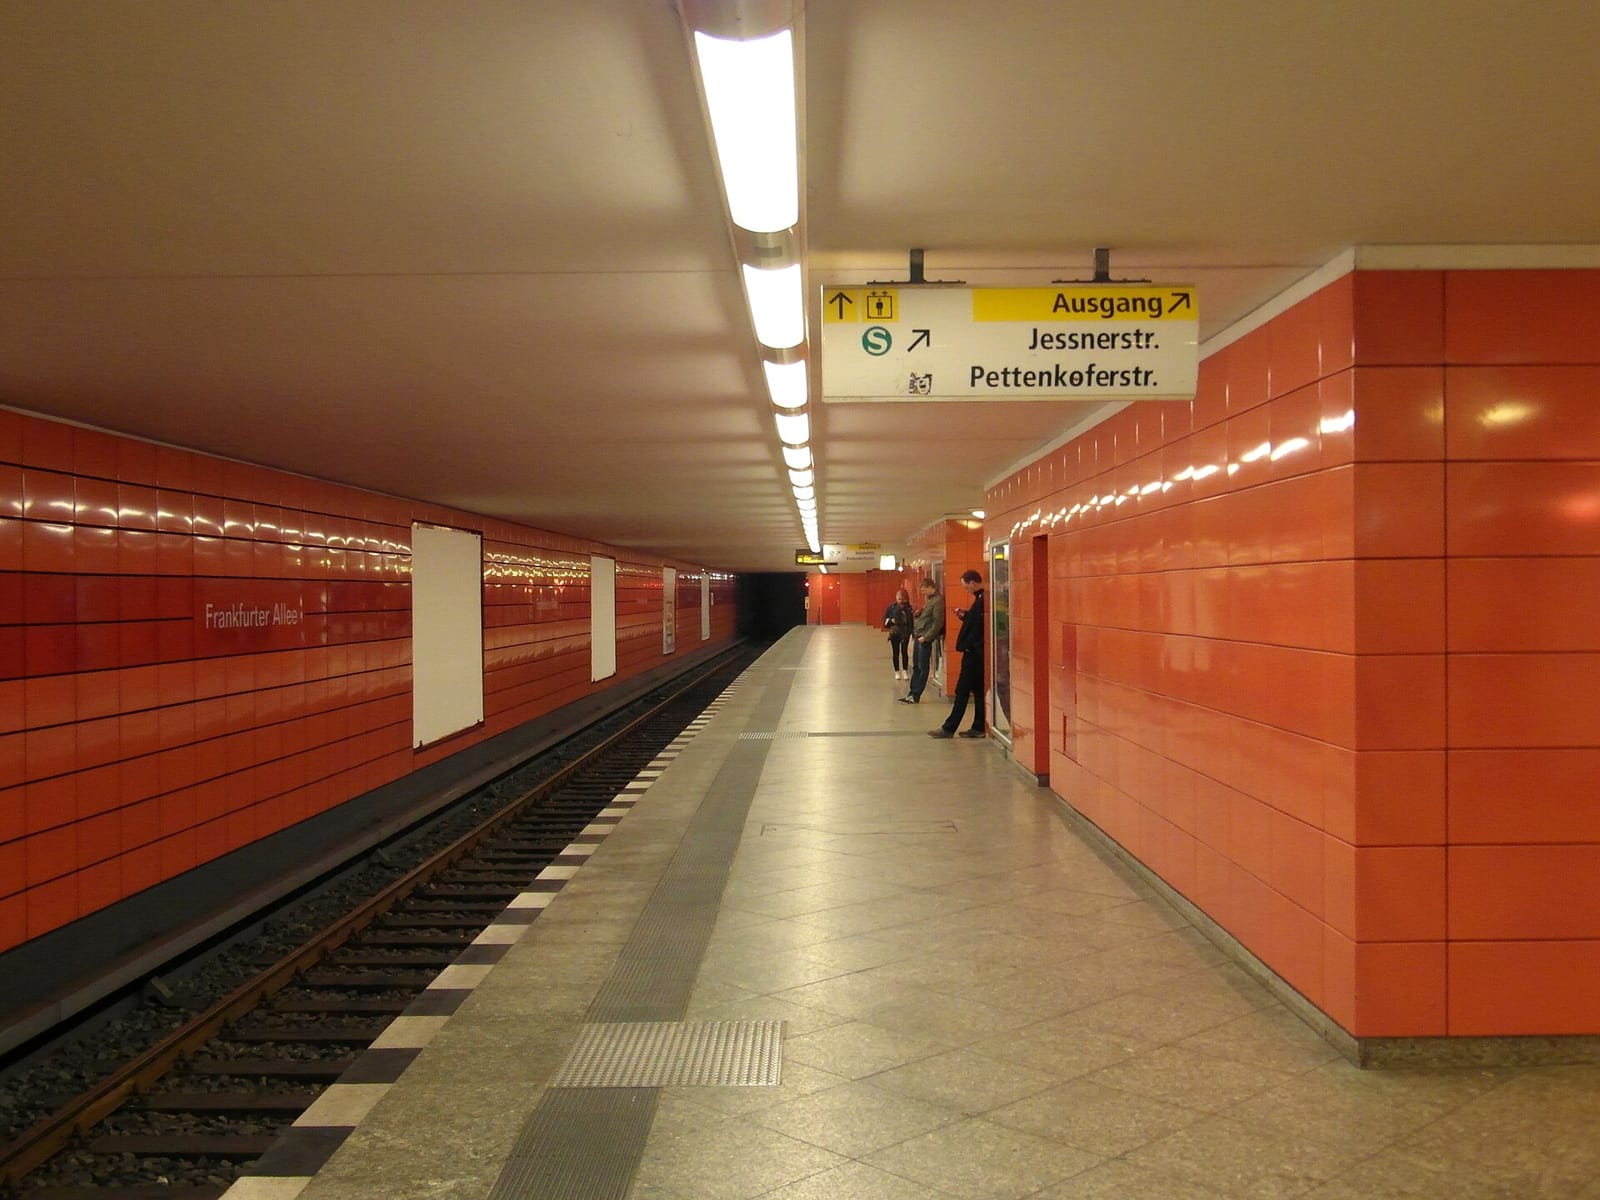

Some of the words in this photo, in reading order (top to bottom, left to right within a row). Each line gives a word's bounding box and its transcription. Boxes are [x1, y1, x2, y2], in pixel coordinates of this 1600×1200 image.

[1052, 292, 1163, 318] Ausgang
[864, 328, 890, 354] S
[1028, 328, 1160, 350] Jessnerstr.
[970, 364, 1158, 388] Pettenkoferstr.
[205, 602, 270, 629] Frankfurter
[272, 602, 298, 625] Allee
